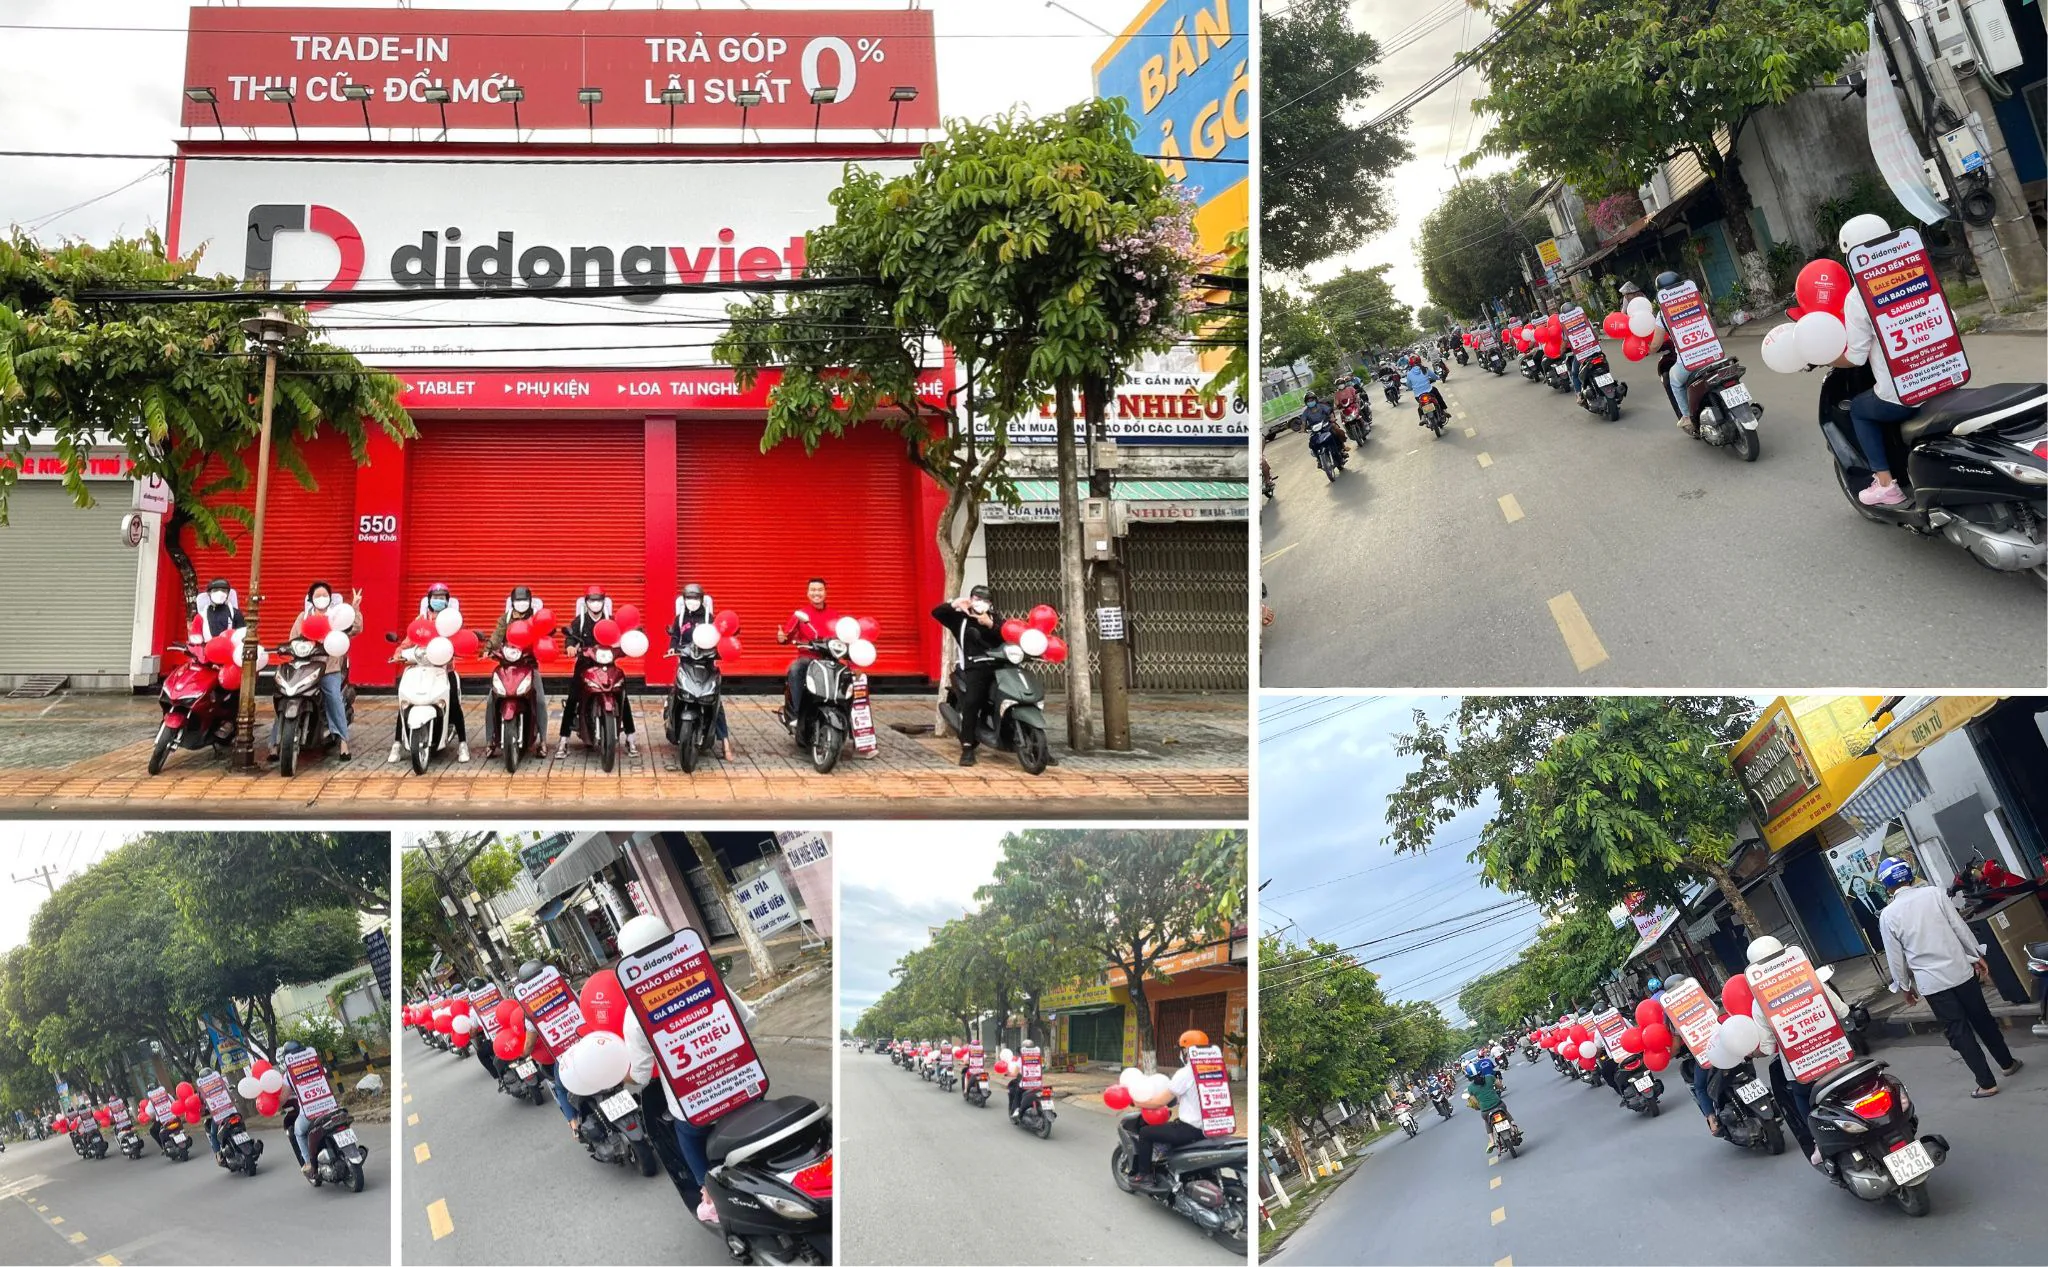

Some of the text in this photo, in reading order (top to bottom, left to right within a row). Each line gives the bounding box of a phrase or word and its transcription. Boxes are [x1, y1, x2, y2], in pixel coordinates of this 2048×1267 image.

[290, 36, 449, 62] TRADE-IN
[644, 31, 788, 63] TRẢ GÓP
[1871, 240, 1911, 260] didongviet
[391, 226, 808, 306] didongviet
[1863, 253, 1921, 280] CHÀO BẾN TRE
[1874, 281, 1891, 292] SALE
[1877, 280, 1929, 305] GIÁ BAO NGON
[1890, 297, 1926, 315] SAMSUNG
[1681, 328, 1710, 345] 63%
[1889, 315, 1943, 352] 3 TRIỆU
[1912, 333, 1930, 345] VNĐ
[416, 380, 476, 395] TABLET
[516, 379, 590, 399] PHỤ KIỆN
[629, 382, 662, 396] LOA
[669, 382, 694, 396] TAI
[1029, 423, 1056, 432] MUA
[1207, 424, 1225, 434] XE
[359, 515, 396, 533] 550
[1911, 724, 1931, 744] ĐIỆN
[635, 957, 702, 995] CHÀO BẾN TRE
[648, 993, 667, 1006] SALE
[653, 986, 712, 1021] GIÁ BAO NGON
[669, 1006, 709, 1031] SAMSUNG
[1782, 1010, 1827, 1043] 3 TRIỆU
[547, 1027, 561, 1042] 3
[679, 1021, 712, 1041] GIẢM ĐẾN
[1688, 1030, 1700, 1043] 3
[669, 1023, 731, 1071] 3 TRIỆU
[696, 1045, 718, 1060] VNĐ
[303, 1086, 327, 1100] 63%
[687, 1092, 702, 1104] 550
[1203, 1094, 1212, 1106] 3
[1889, 1144, 1921, 1168] 64-B2
[1894, 1160, 1931, 1182] 342.94
